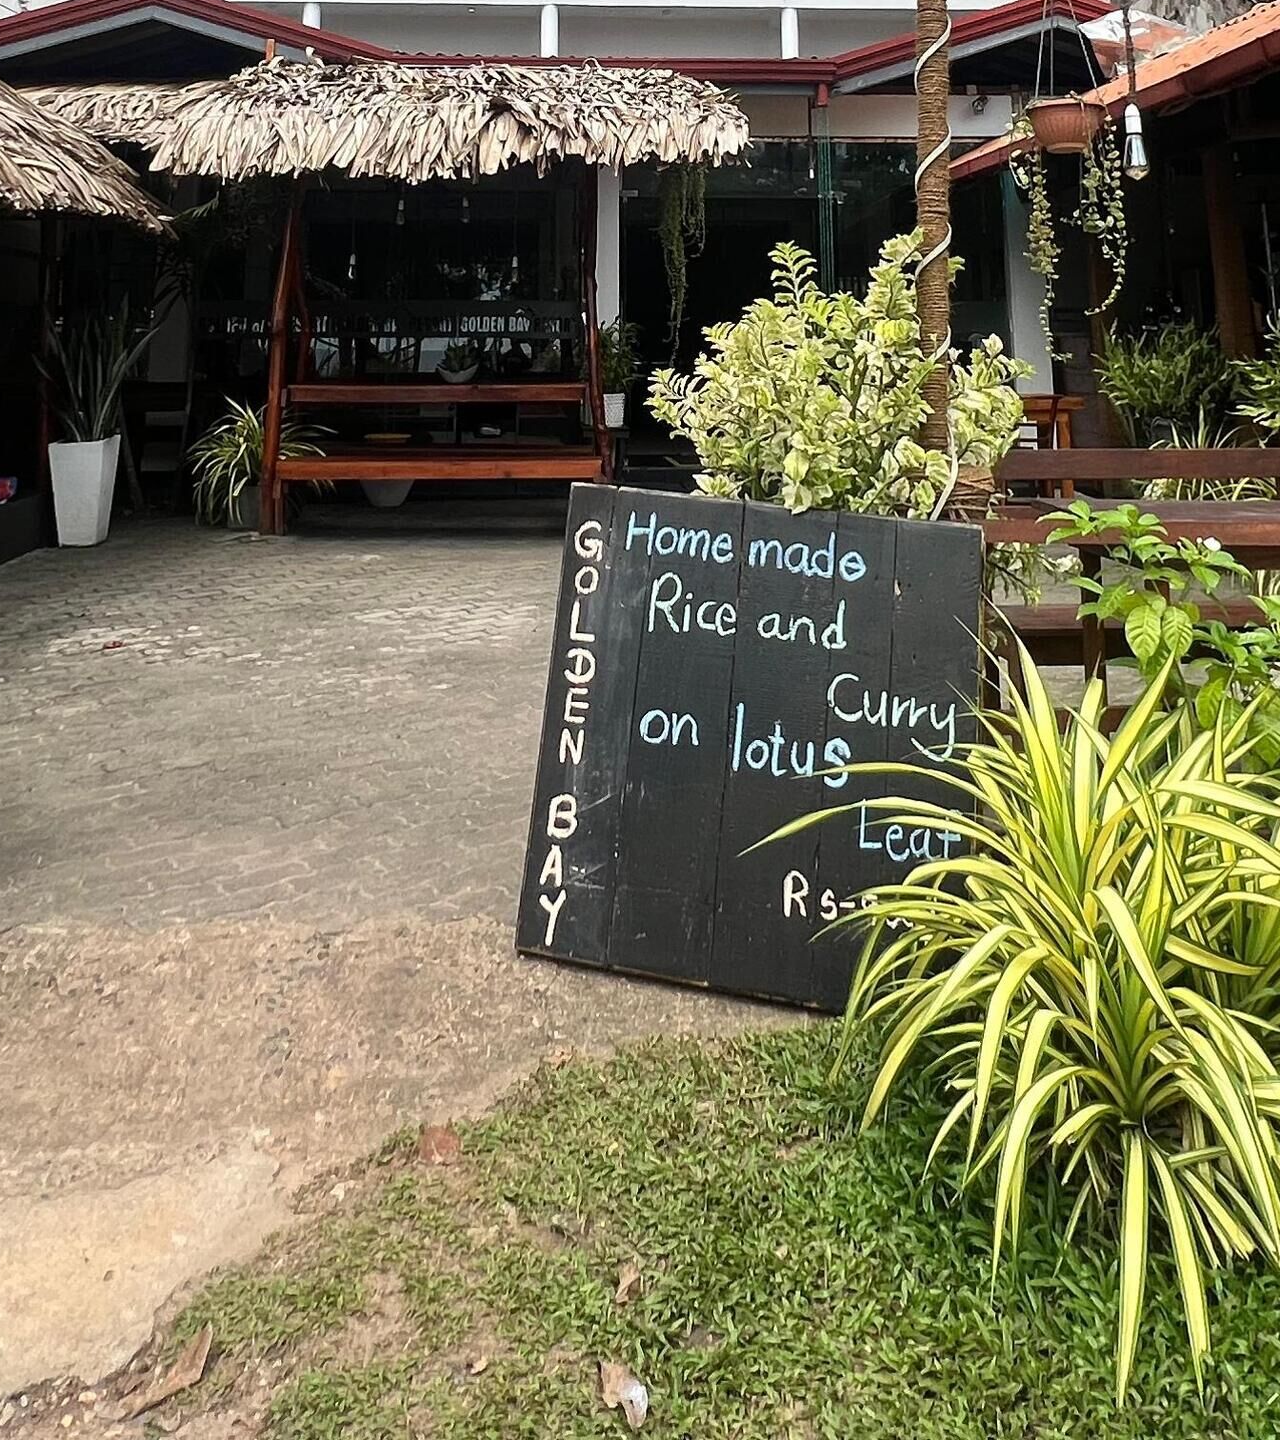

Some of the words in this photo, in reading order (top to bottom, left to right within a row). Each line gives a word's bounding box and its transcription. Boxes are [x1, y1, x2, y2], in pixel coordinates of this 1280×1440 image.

[460, 316, 505, 333] GOLDEN
[624, 510, 734, 564] Home
[748, 531, 867, 582] made
[558, 519, 604, 766] GOLDEN
[647, 571, 737, 637] Rice
[757, 598, 847, 651] and
[639, 708, 700, 747] on
[731, 702, 852, 789] lotus
[826, 673, 958, 762] Curry
[539, 794, 579, 947] BAY
